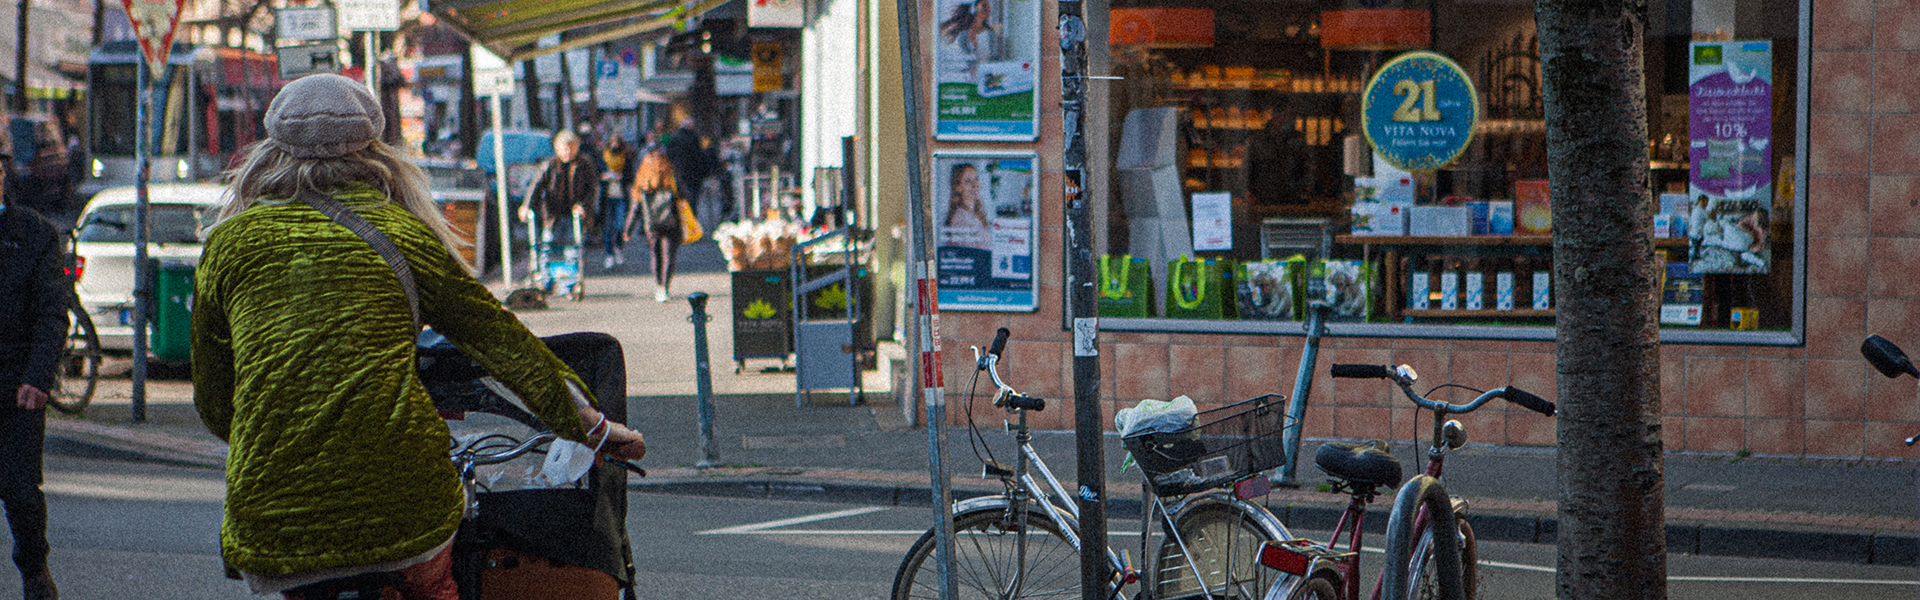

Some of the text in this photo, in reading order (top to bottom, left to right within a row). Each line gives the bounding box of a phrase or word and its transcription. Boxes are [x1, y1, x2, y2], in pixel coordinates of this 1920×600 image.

[1392, 79, 1441, 122] 21
[1384, 125, 1456, 136] VITA NOVA
[1714, 123, 1748, 138] 10%
